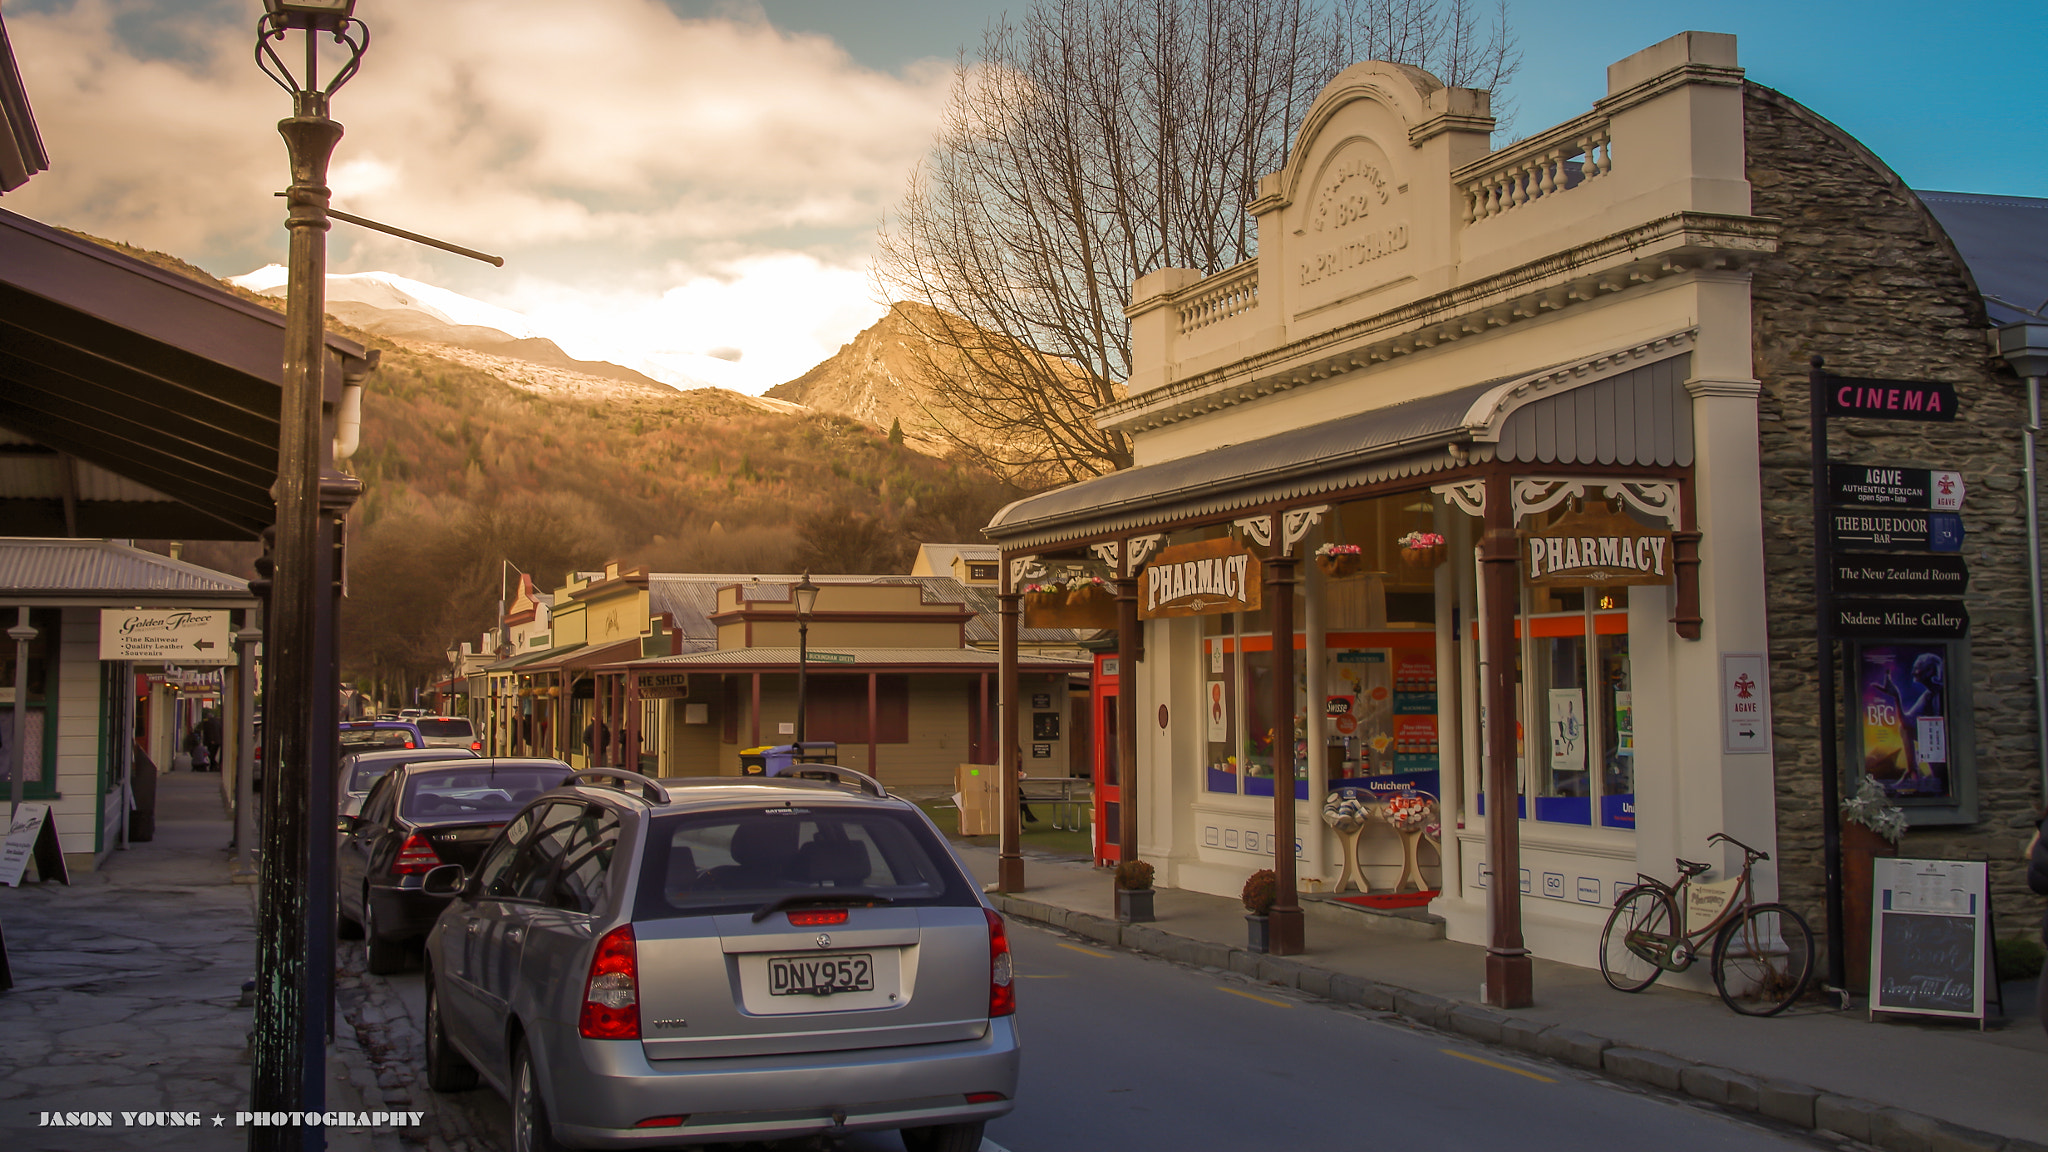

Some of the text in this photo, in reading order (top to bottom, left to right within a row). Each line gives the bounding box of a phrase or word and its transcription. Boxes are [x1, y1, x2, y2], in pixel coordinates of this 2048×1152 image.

[1335, 193, 1369, 229] 1862
[1837, 386, 1942, 412] CINEMA
[1865, 468, 1902, 486] AGAVE
[1842, 484, 1923, 497] AUTHENTIC MEXICAN
[1858, 494, 1875, 502] open
[1875, 495, 1890, 503] 5pm
[1894, 495, 1907, 503] late
[1937, 498, 1956, 506] AGAVE
[1835, 516, 1928, 533] THE BLUE DOOR
[1873, 533, 1891, 543] BAR
[1529, 536, 1666, 578] PHARMACY
[1839, 567, 1961, 580] The New Zealand Room
[1147, 554, 1248, 611] PHARMACY
[119, 616, 164, 635] Golden
[165, 612, 212, 631] Fleece
[1840, 611, 1962, 630] Nadene Milne Gallery
[125, 643, 152, 651] Quality
[656, 674, 684, 686] SHED
[1326, 701, 1348, 713] Swisse
[1734, 703, 1757, 713] AGAVE
[1867, 704, 1896, 727] BFG
[1370, 781, 1411, 790] Unichem
[1546, 877, 1561, 888] GO
[773, 960, 870, 991] DNY952
